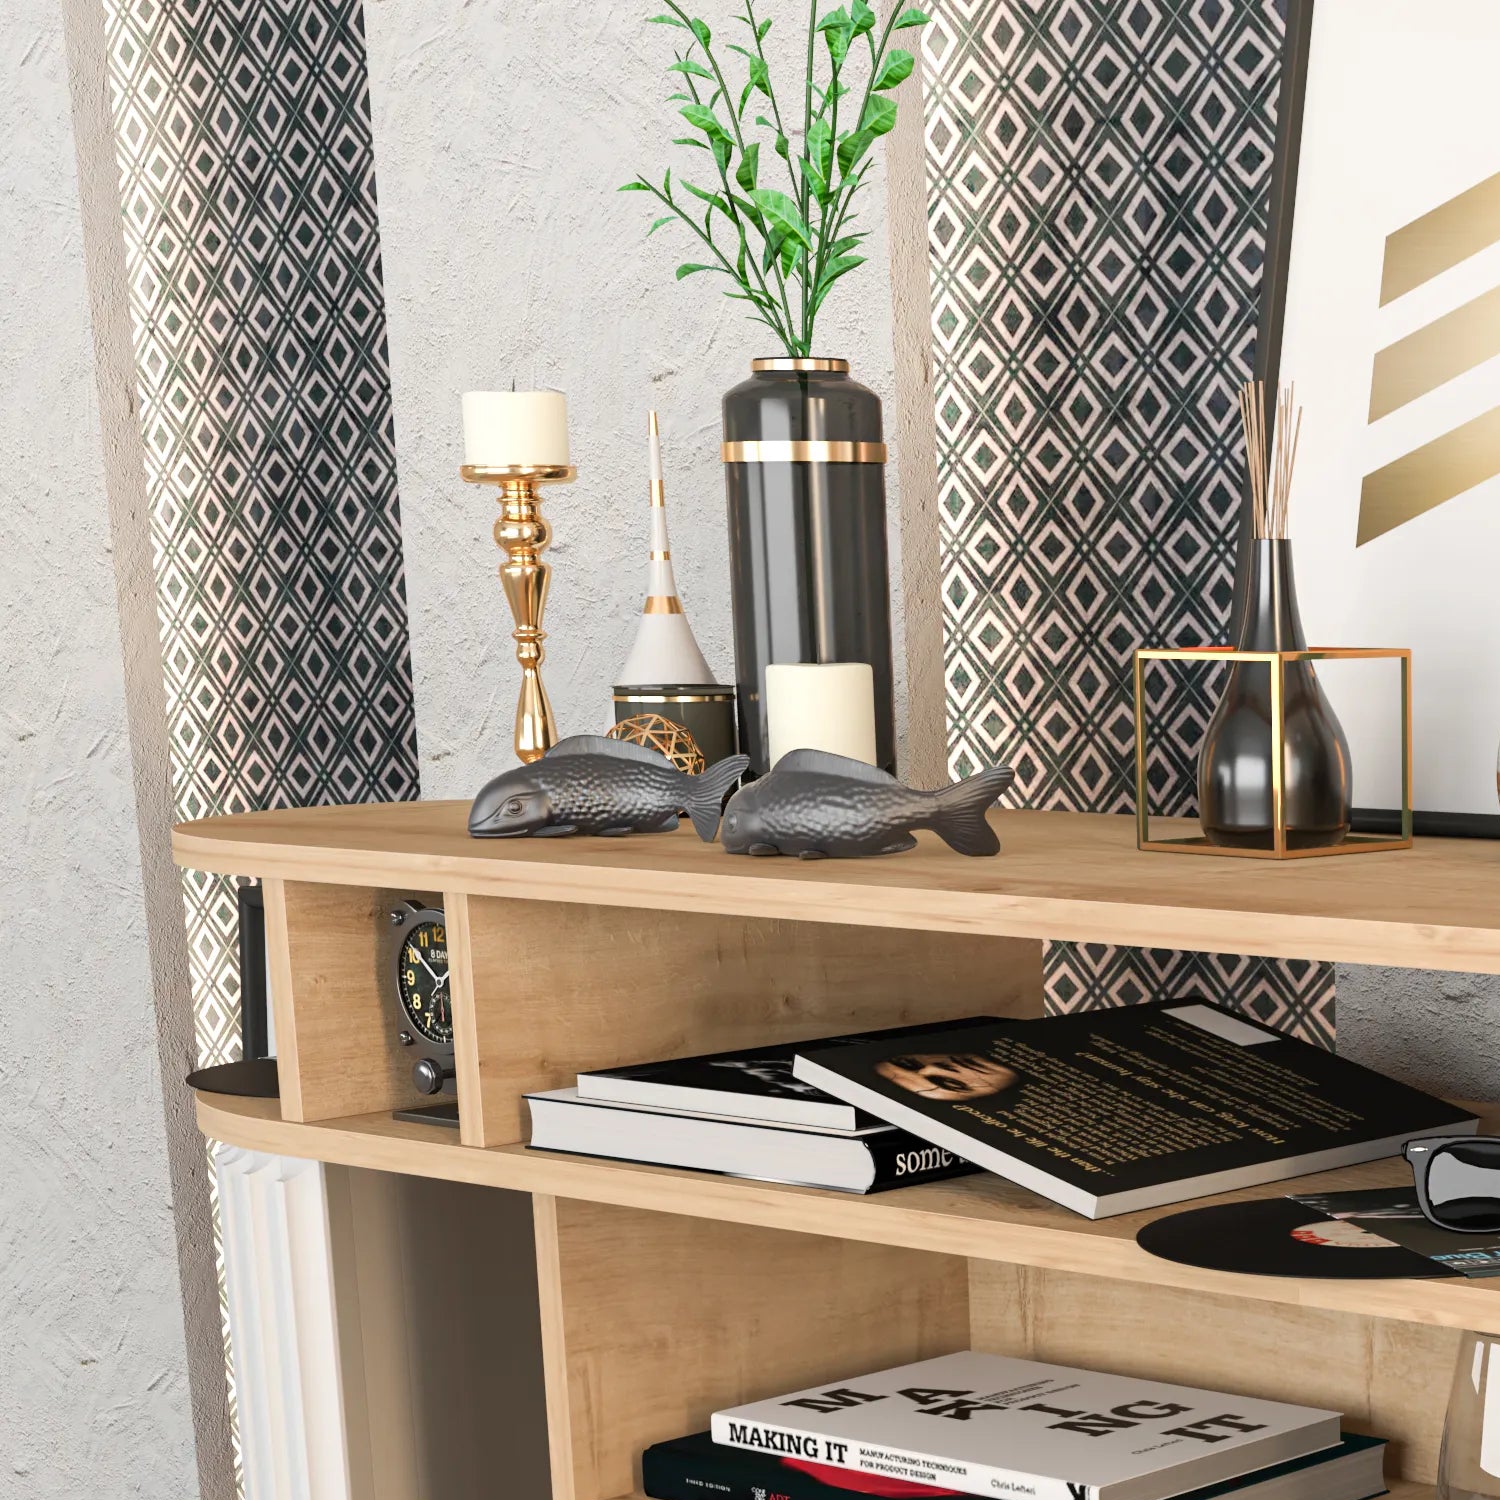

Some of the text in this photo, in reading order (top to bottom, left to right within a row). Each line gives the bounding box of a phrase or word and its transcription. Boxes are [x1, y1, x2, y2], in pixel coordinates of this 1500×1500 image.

[418, 931, 429, 947] 11
[432, 926, 445, 942] 12
[406, 969, 416, 986] 9
[412, 993, 422, 1010] 8
[424, 1012, 432, 1028] 7
[1074, 1051, 1285, 1144] How long can she stay human?
[951, 1104, 1007, 1128] offered?
[1005, 1127, 1027, 1137] he
[1024, 1136, 1048, 1148] life
[1046, 1146, 1071, 1158] the
[896, 1147, 953, 1176] some
[1428, 1249, 1490, 1261] Blue
[779, 1387, 890, 1414] M
[1160, 1413, 1269, 1444] IT
[728, 1422, 848, 1464] MAKING IT
[859, 1447, 920, 1468] MANUFACTURING
[860, 1459, 937, 1481] FOR PRODUCT DESIGN
[706, 1481, 731, 1493] EDITION
[991, 1478, 1012, 1490] Chris
